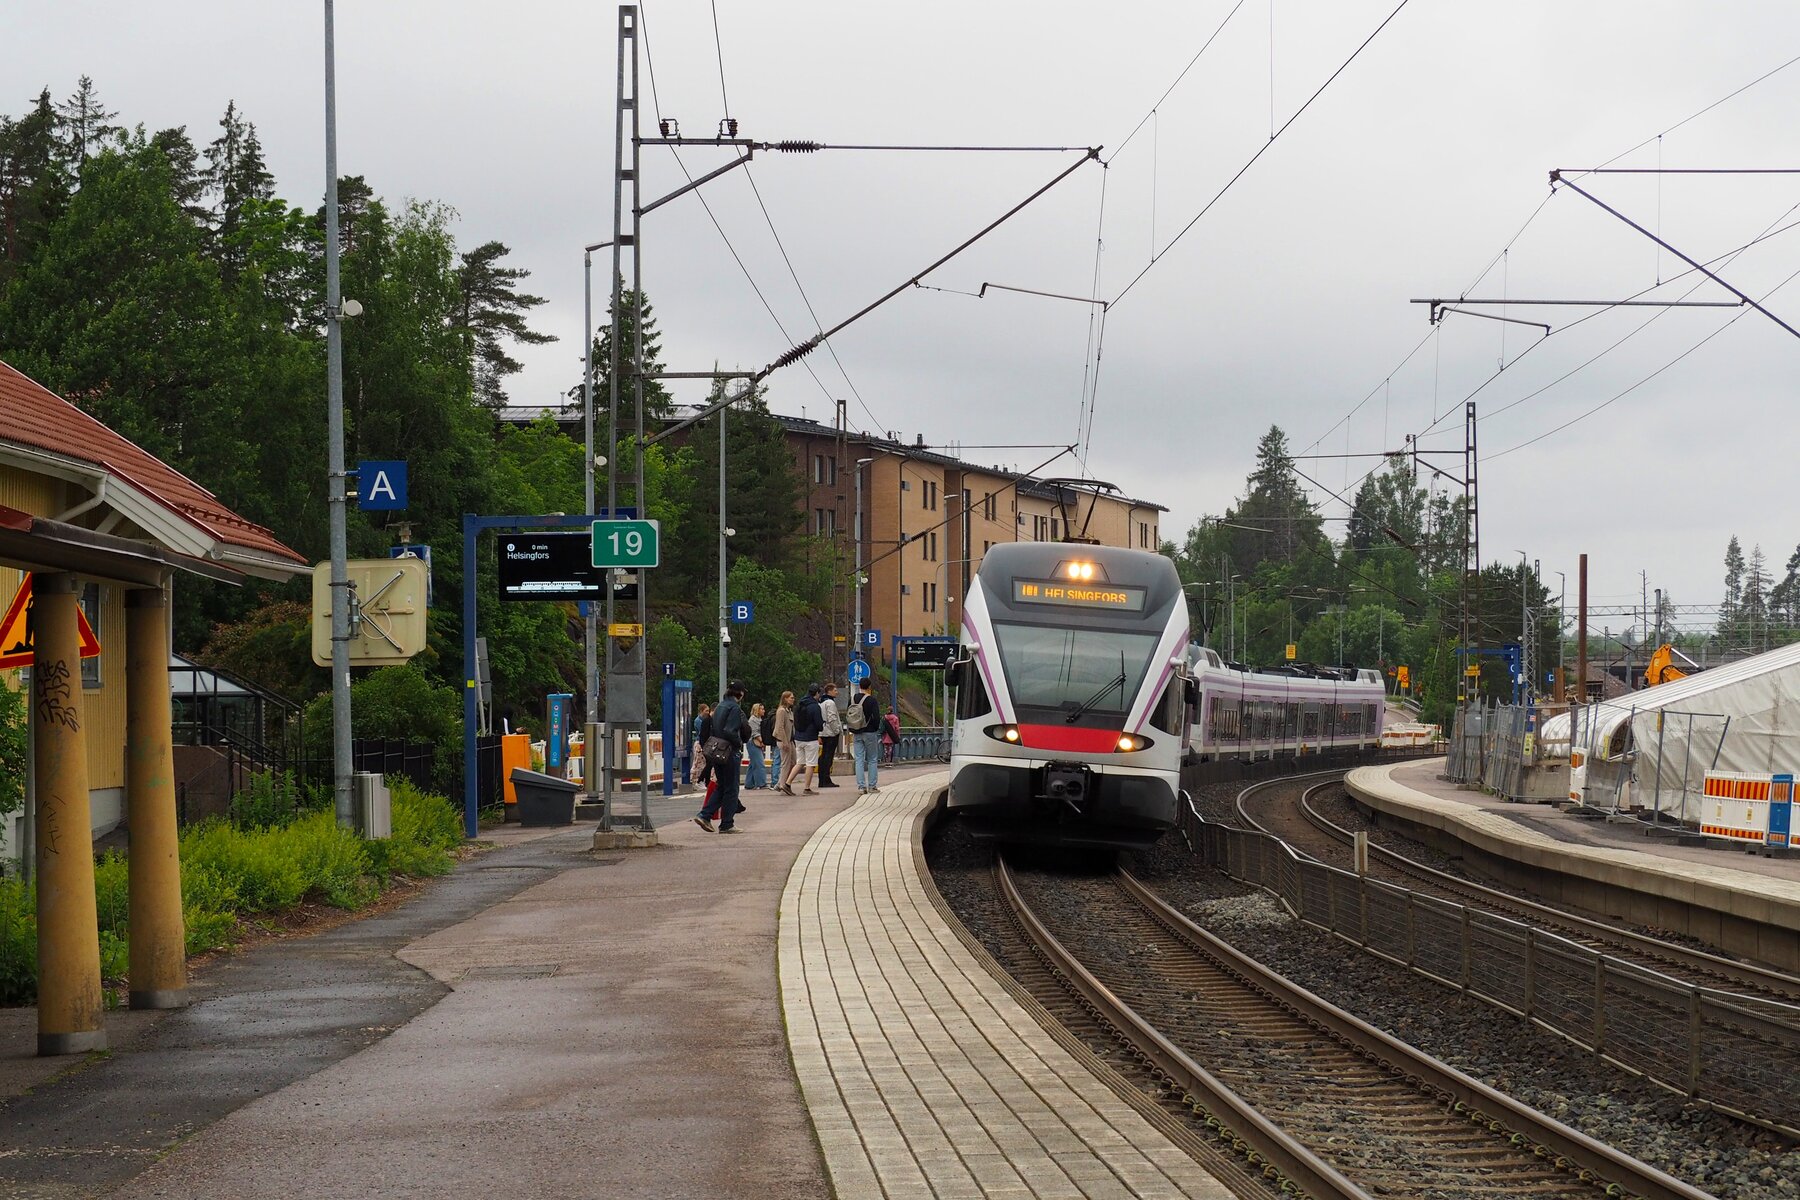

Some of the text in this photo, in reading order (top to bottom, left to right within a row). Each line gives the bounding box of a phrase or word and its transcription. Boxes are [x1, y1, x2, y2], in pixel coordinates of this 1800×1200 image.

[369, 470, 396, 501] A
[607, 531, 643, 556] 19
[507, 552, 550, 561] Helsingfors
[737, 605, 749, 620] B
[868, 632, 877, 644] B
[949, 647, 954, 655] 2
